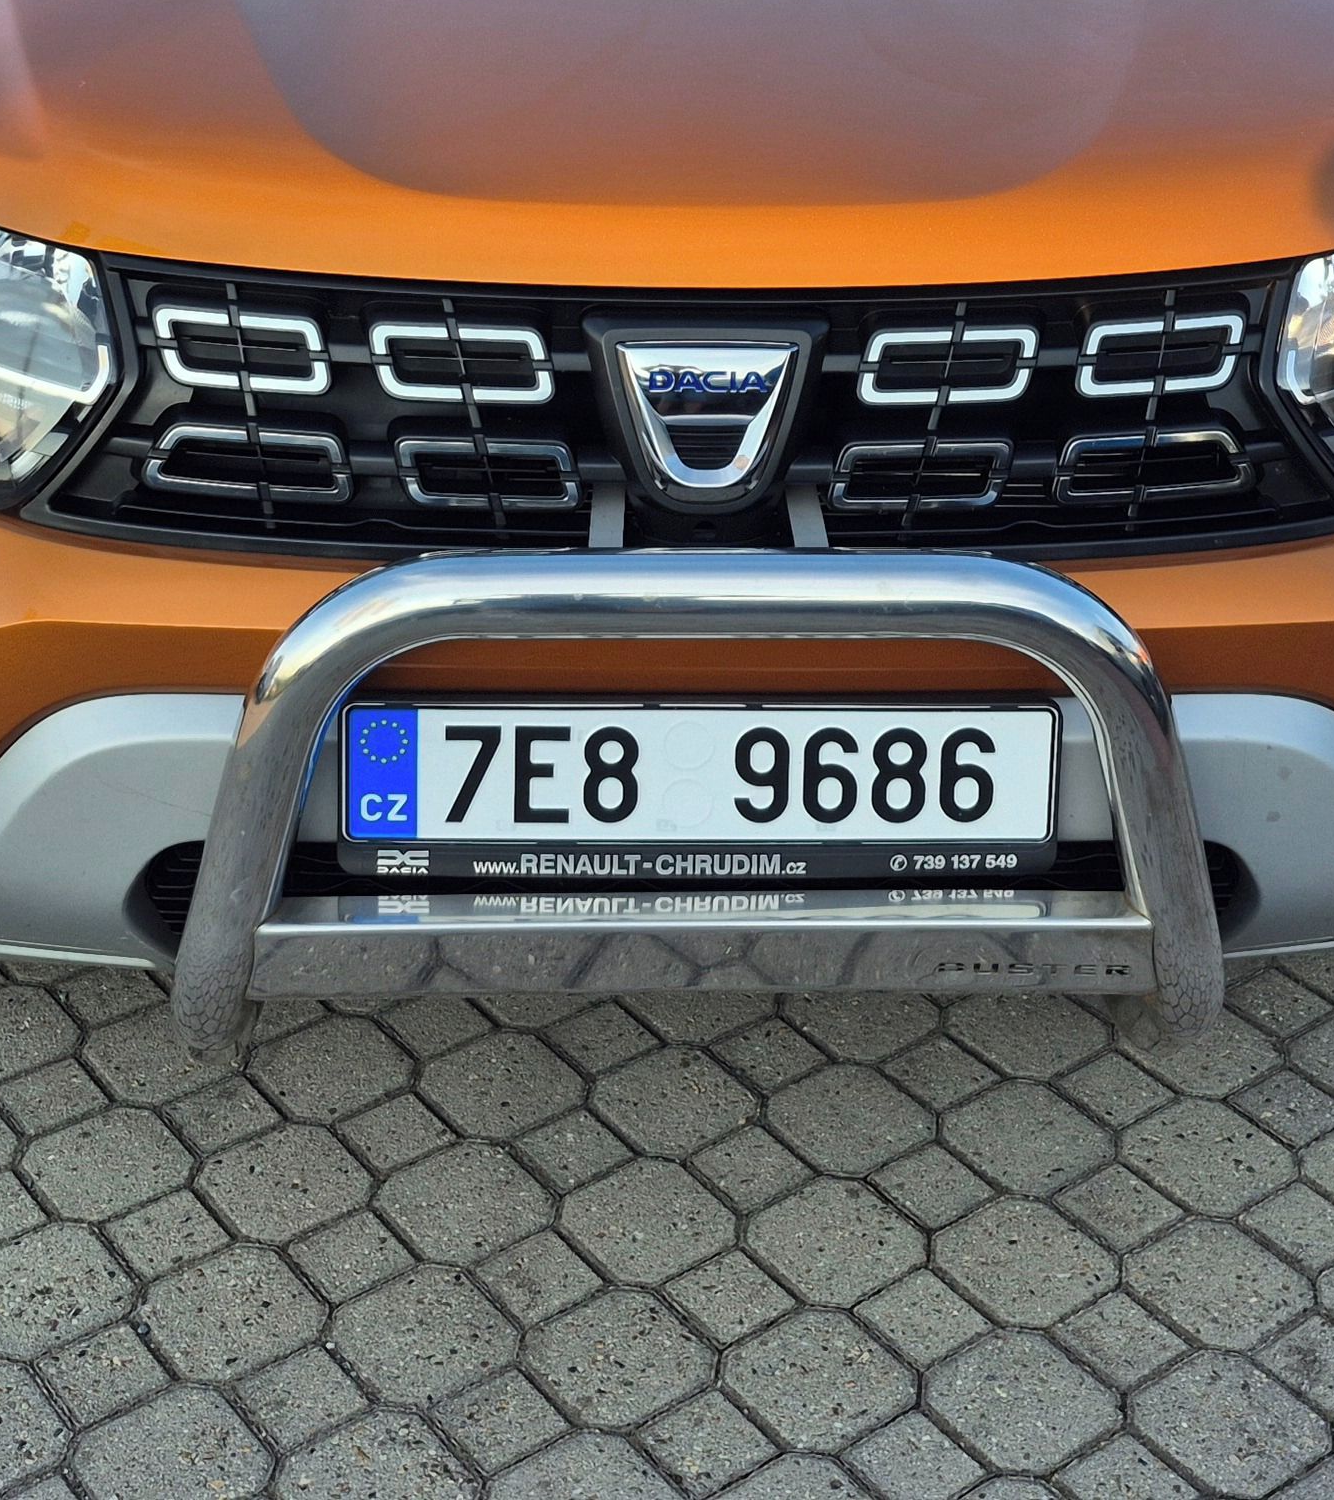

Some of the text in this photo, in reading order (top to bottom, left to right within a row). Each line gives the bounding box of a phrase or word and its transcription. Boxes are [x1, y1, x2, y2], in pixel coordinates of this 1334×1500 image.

[648, 371, 768, 394] DACIA
[444, 724, 997, 824] 7E8 9686
[360, 793, 409, 822] CZ
[376, 866, 429, 875] DACIA
[472, 853, 807, 876] www.RENAULT-CHRUDIM.cz
[912, 853, 1018, 870] 739 137 549
